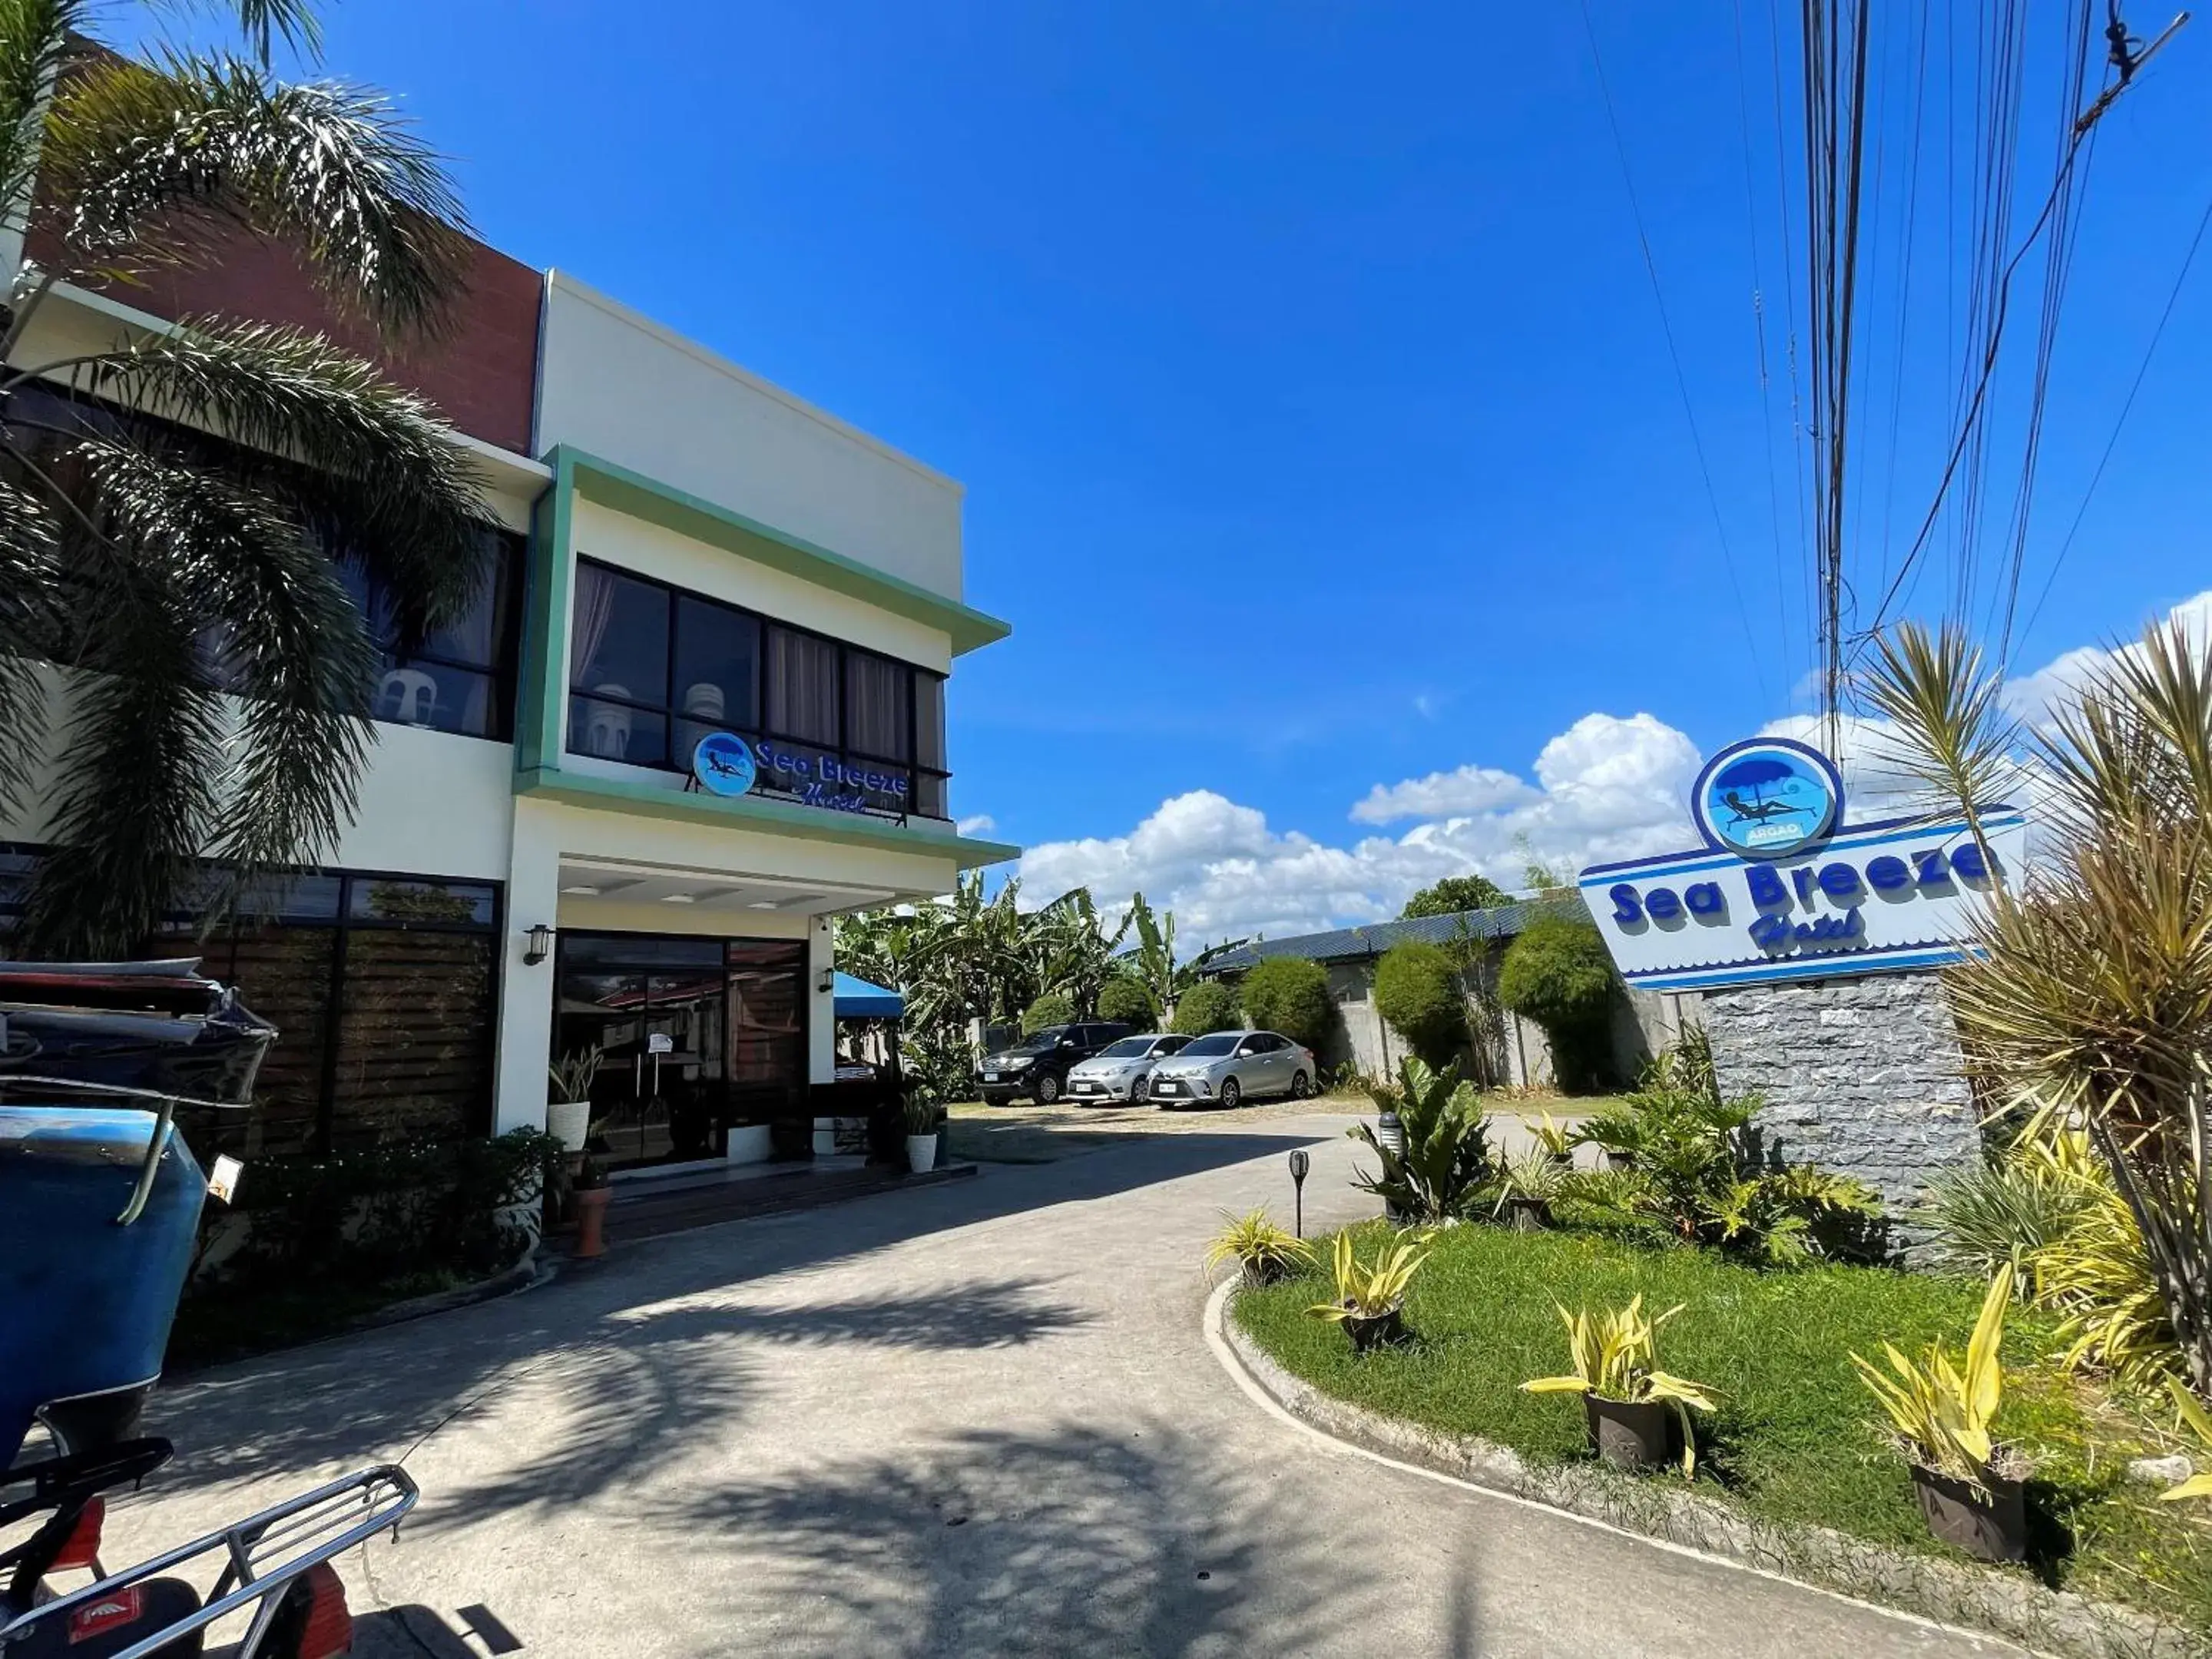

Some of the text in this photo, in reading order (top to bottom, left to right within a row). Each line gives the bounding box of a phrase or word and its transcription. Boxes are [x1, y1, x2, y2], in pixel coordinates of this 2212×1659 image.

[756, 741, 909, 796] Sea Breeze
[1610, 843, 2001, 927] Sea Breeze
[1748, 905, 1861, 948] Hotel
